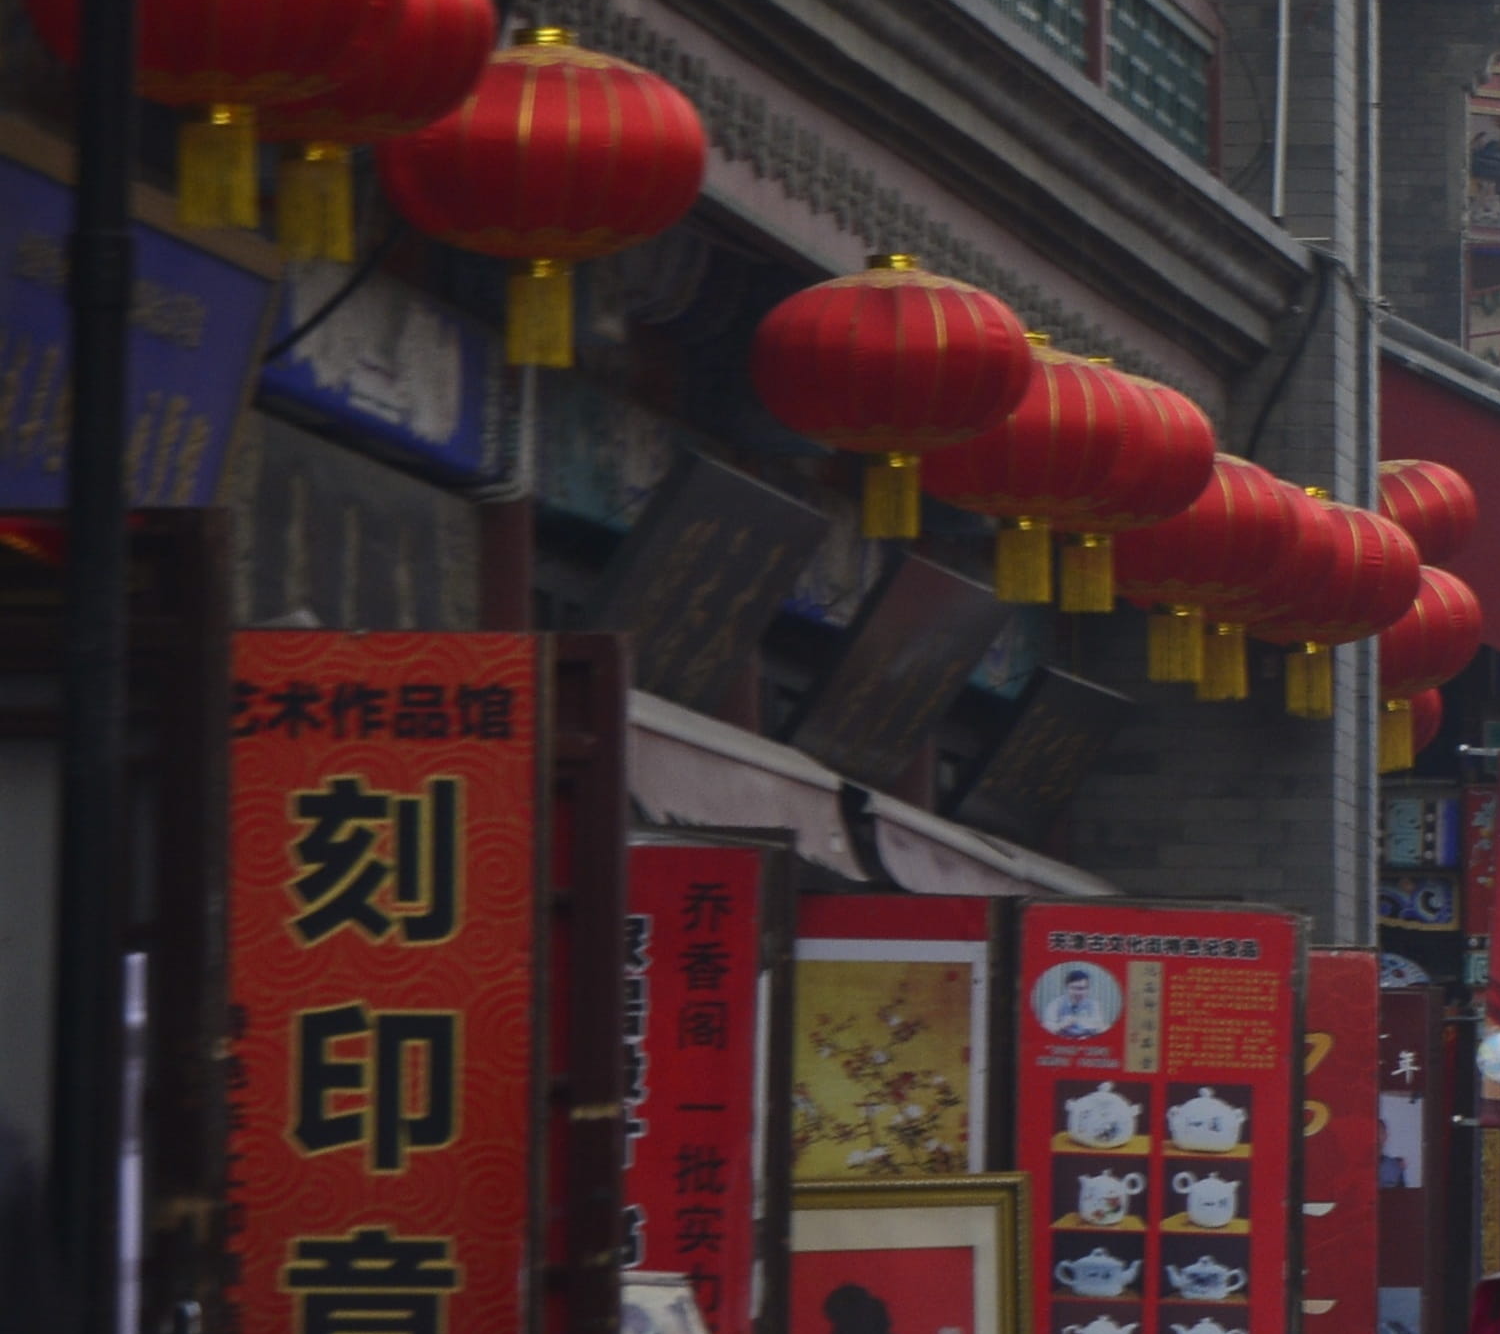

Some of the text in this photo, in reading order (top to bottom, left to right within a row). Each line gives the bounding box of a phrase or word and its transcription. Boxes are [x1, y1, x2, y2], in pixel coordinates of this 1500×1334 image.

[1047, 931, 1260, 959] 天津古文化街特色纪念品
[673, 1101, 728, 1334] 一批实力
